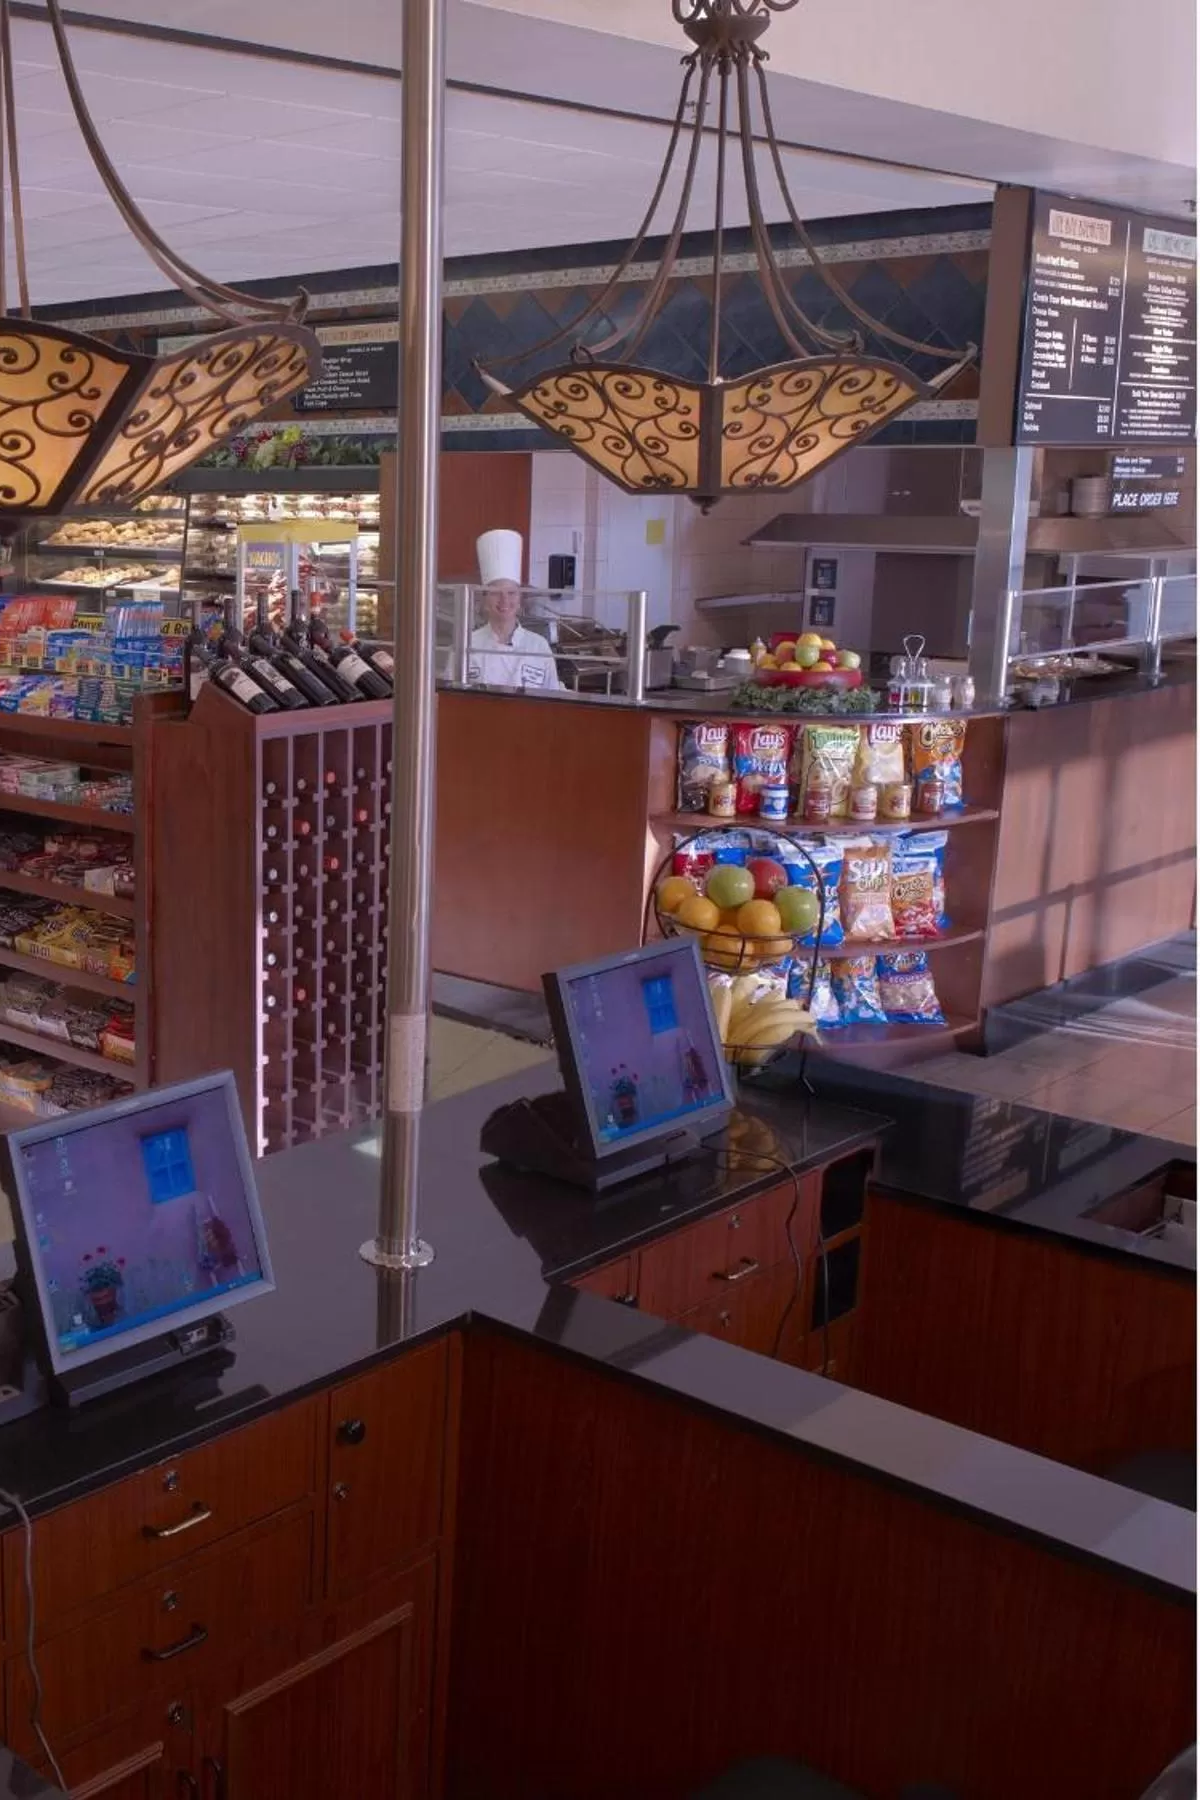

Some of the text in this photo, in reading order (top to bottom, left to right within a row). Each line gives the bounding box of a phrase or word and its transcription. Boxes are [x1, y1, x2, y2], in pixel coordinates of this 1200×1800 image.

[1112, 492, 1179, 506] PLACE ORDER HERE
[753, 732, 785, 750] Lay's
[848, 859, 888, 883] Sun
